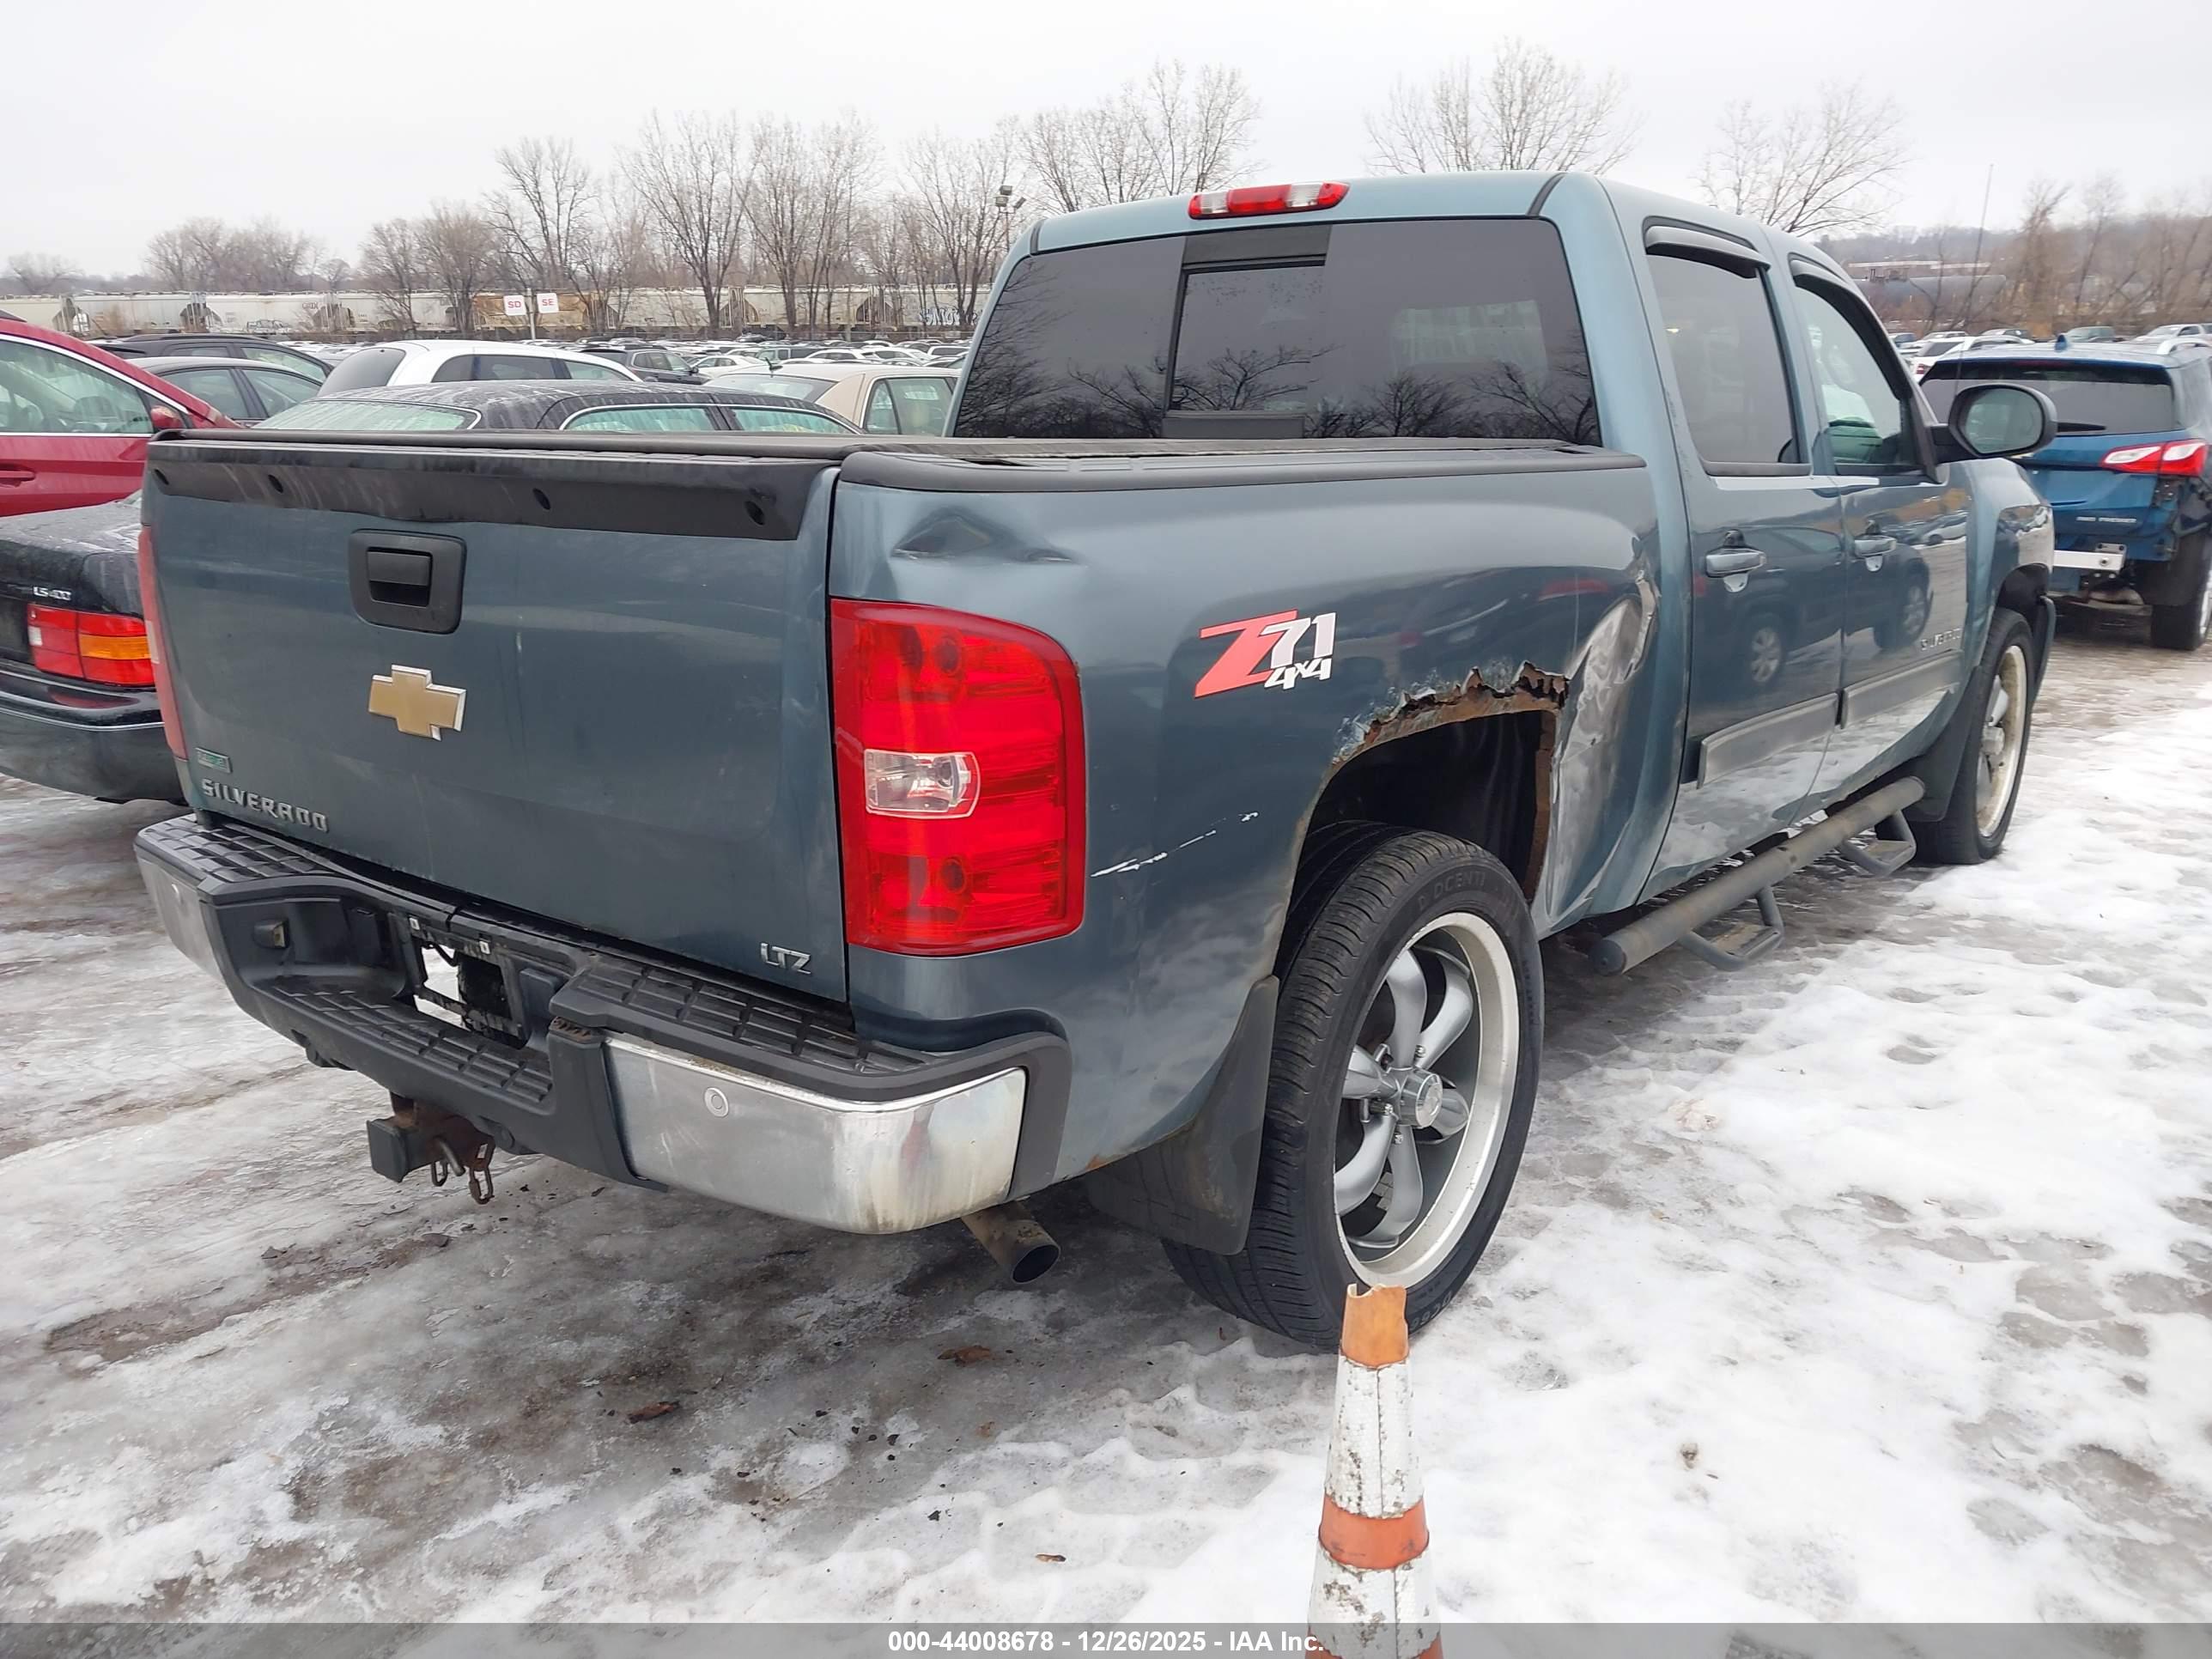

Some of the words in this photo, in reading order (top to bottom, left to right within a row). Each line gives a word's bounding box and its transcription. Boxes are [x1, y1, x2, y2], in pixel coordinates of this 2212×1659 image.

[1194, 609, 1336, 700] Z71
[201, 778, 330, 832] SILVERADO
[760, 942, 811, 975] LTZ
